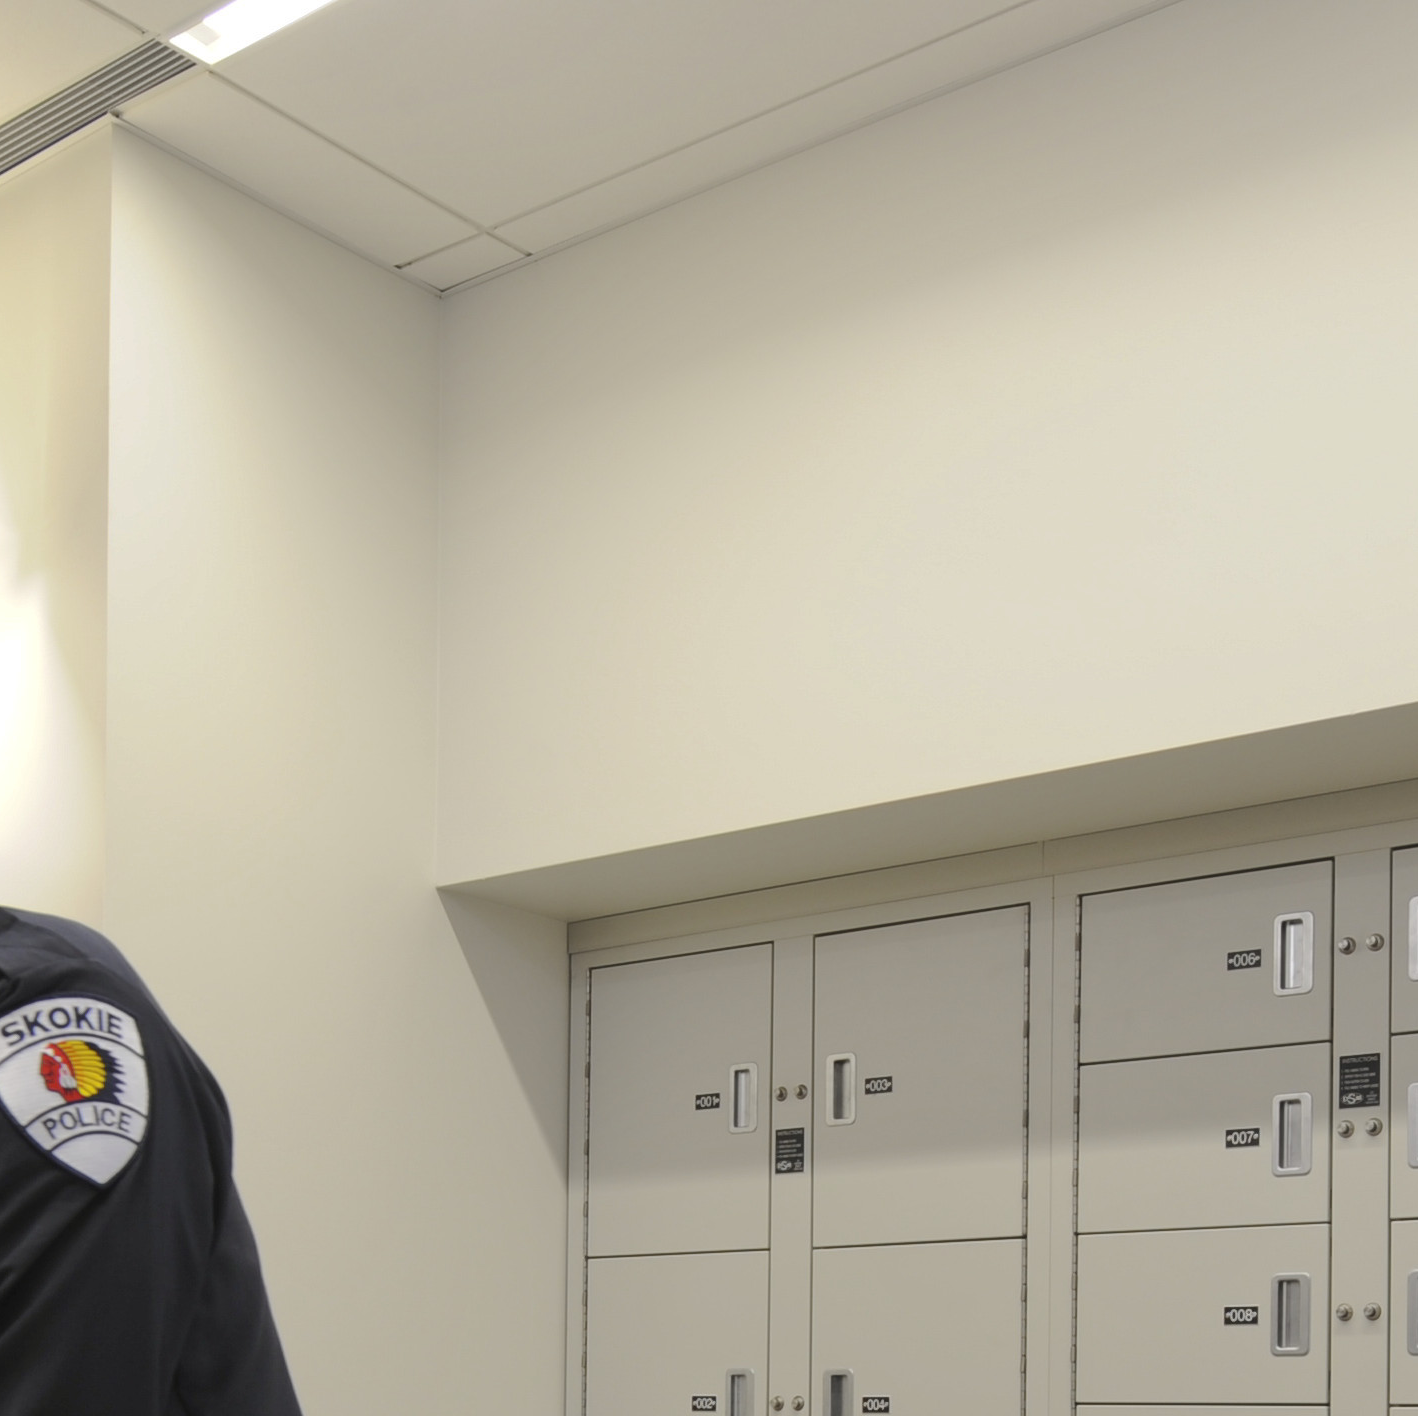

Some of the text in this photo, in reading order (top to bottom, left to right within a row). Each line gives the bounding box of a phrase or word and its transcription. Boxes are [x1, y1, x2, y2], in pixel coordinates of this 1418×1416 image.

[1233, 952, 1256, 967] 006
[1, 1006, 123, 1047] SKOKIE
[870, 1079, 887, 1091] 003
[701, 1096, 717, 1107] 001
[42, 1104, 132, 1139] POLICE
[1231, 1130, 1254, 1145] 007
[1230, 1309, 1252, 1323] 008
[696, 1397, 712, 1409] 002
[867, 1398, 885, 1410] 004
